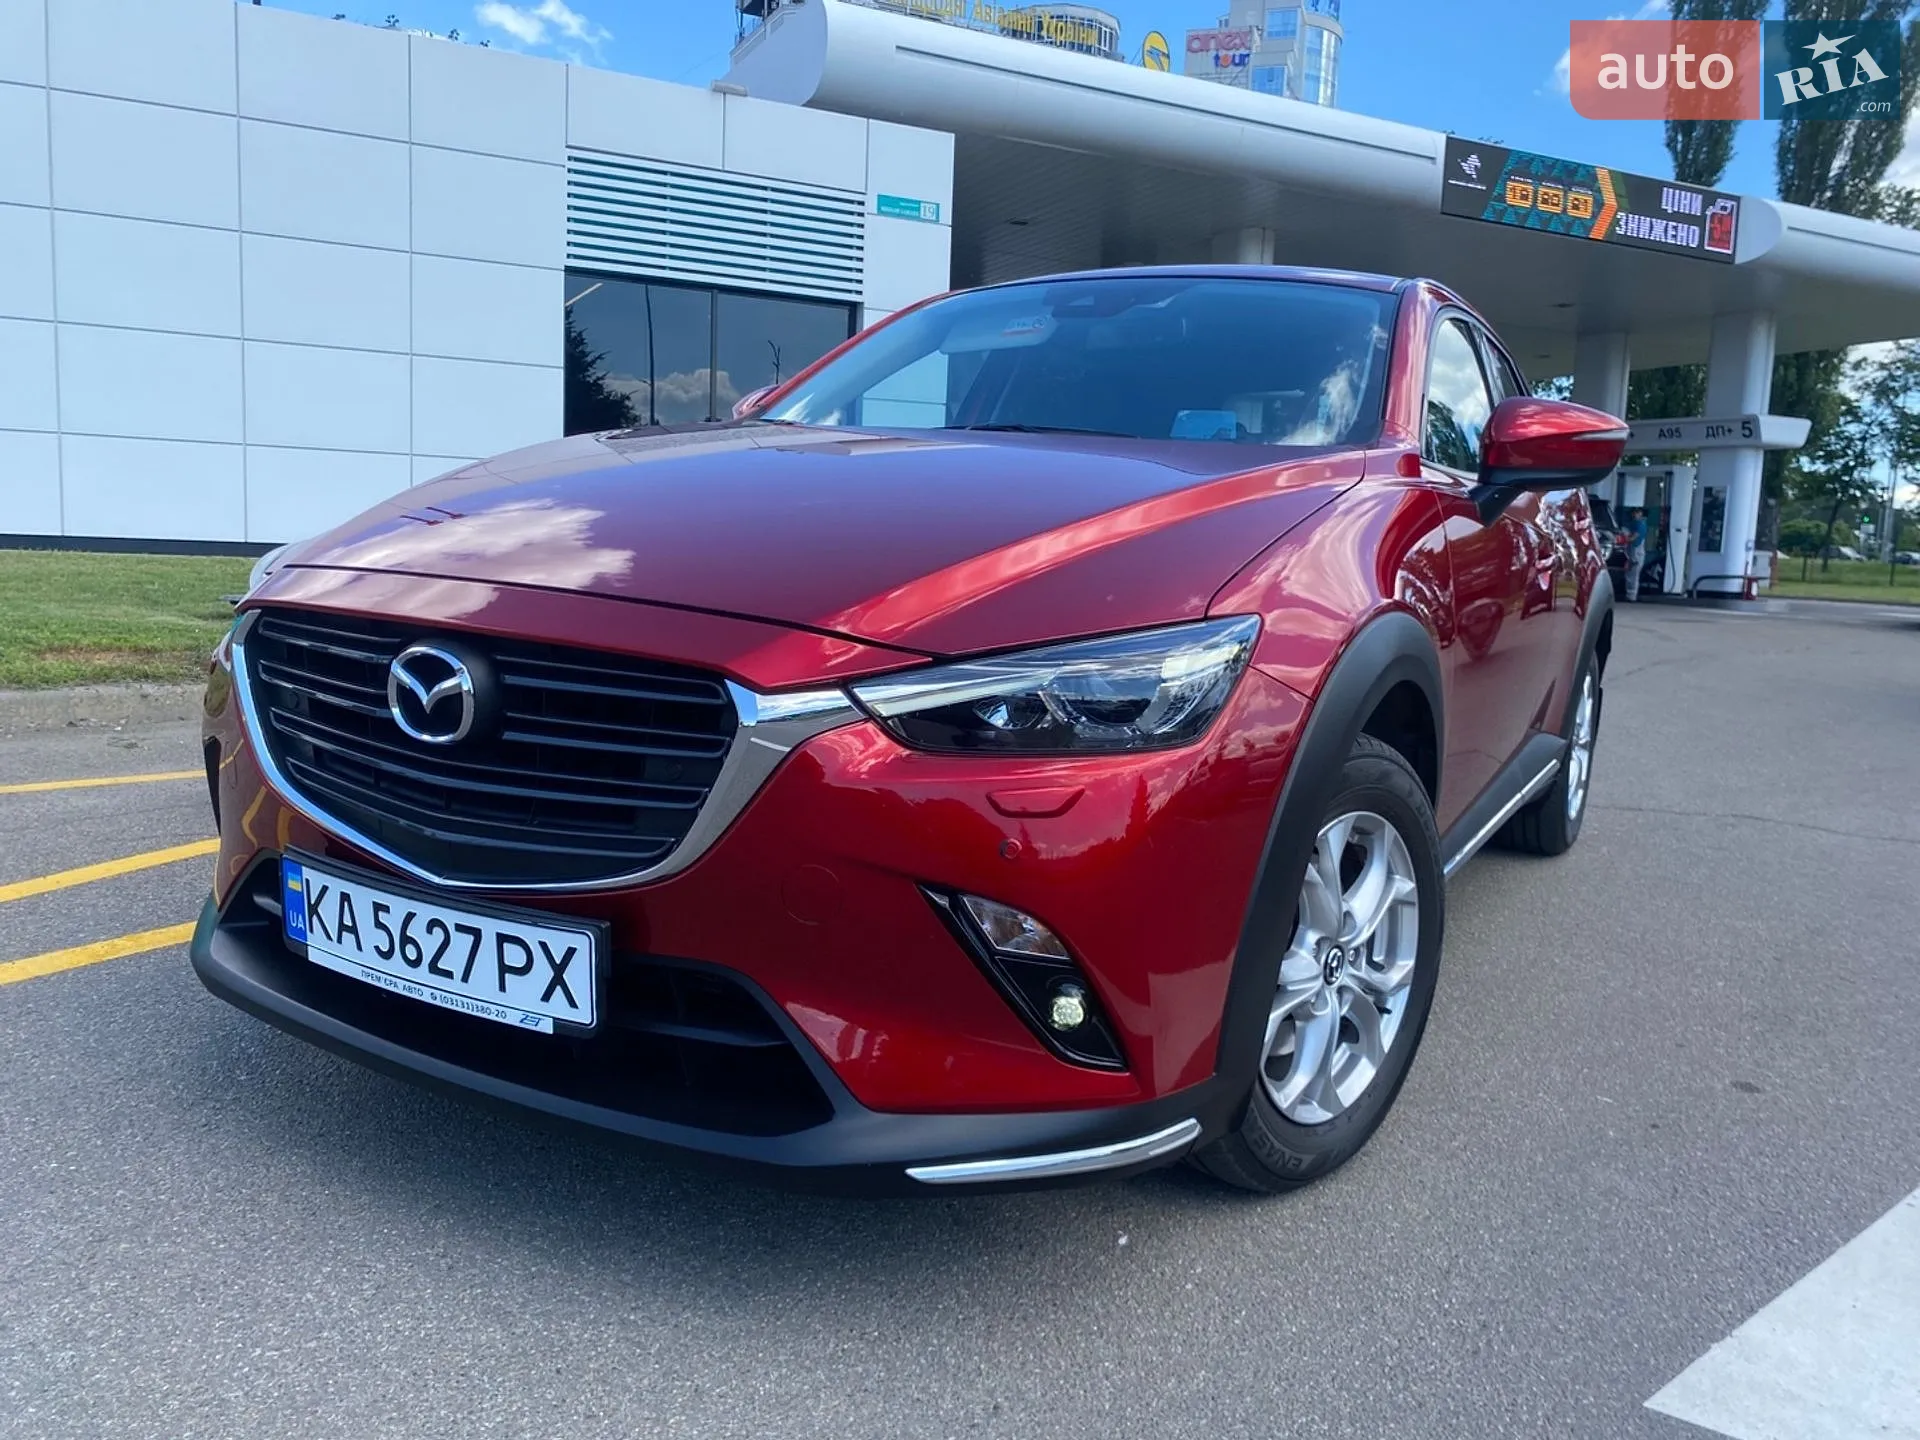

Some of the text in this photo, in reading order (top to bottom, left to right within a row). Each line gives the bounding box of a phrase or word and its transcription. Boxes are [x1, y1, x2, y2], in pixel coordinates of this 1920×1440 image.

[1041, 10, 1098, 47] України
[1661, 187, 1702, 216] ЦІНИ
[1615, 212, 1700, 248] ЗНИЖЕНО
[1705, 425, 1733, 440] ДП+
[1741, 420, 1753, 439] 5
[289, 910, 305, 930] UA
[304, 877, 580, 1010] KA 5627 PX
[402, 984, 423, 998] АВТО
